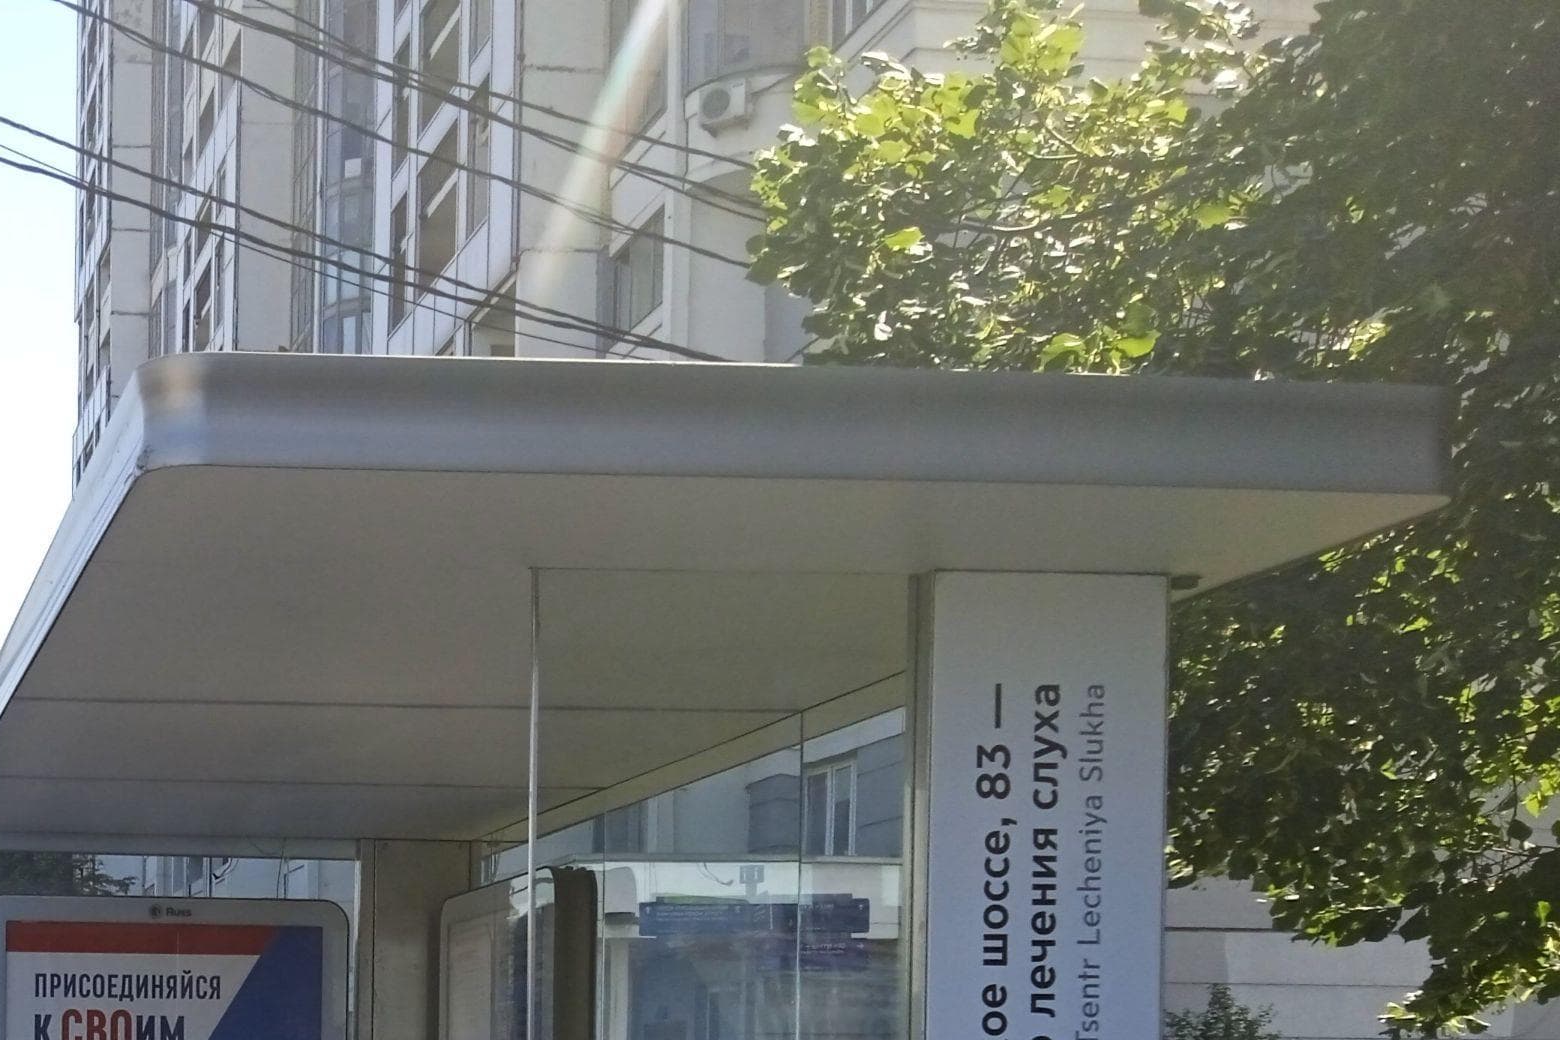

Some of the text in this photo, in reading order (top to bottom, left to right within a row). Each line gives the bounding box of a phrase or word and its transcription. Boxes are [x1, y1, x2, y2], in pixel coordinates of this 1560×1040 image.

[976, 744, 1011, 799] 83
[1032, 684, 1068, 809] слуха
[1078, 685, 1105, 781] Slukha
[983, 818, 1018, 966] шоссе,
[1030, 828, 1058, 1018] лечения
[1076, 795, 1107, 944] Lecheniya
[34, 970, 221, 1002] ПРИСОЕДИНЯЙСЯ
